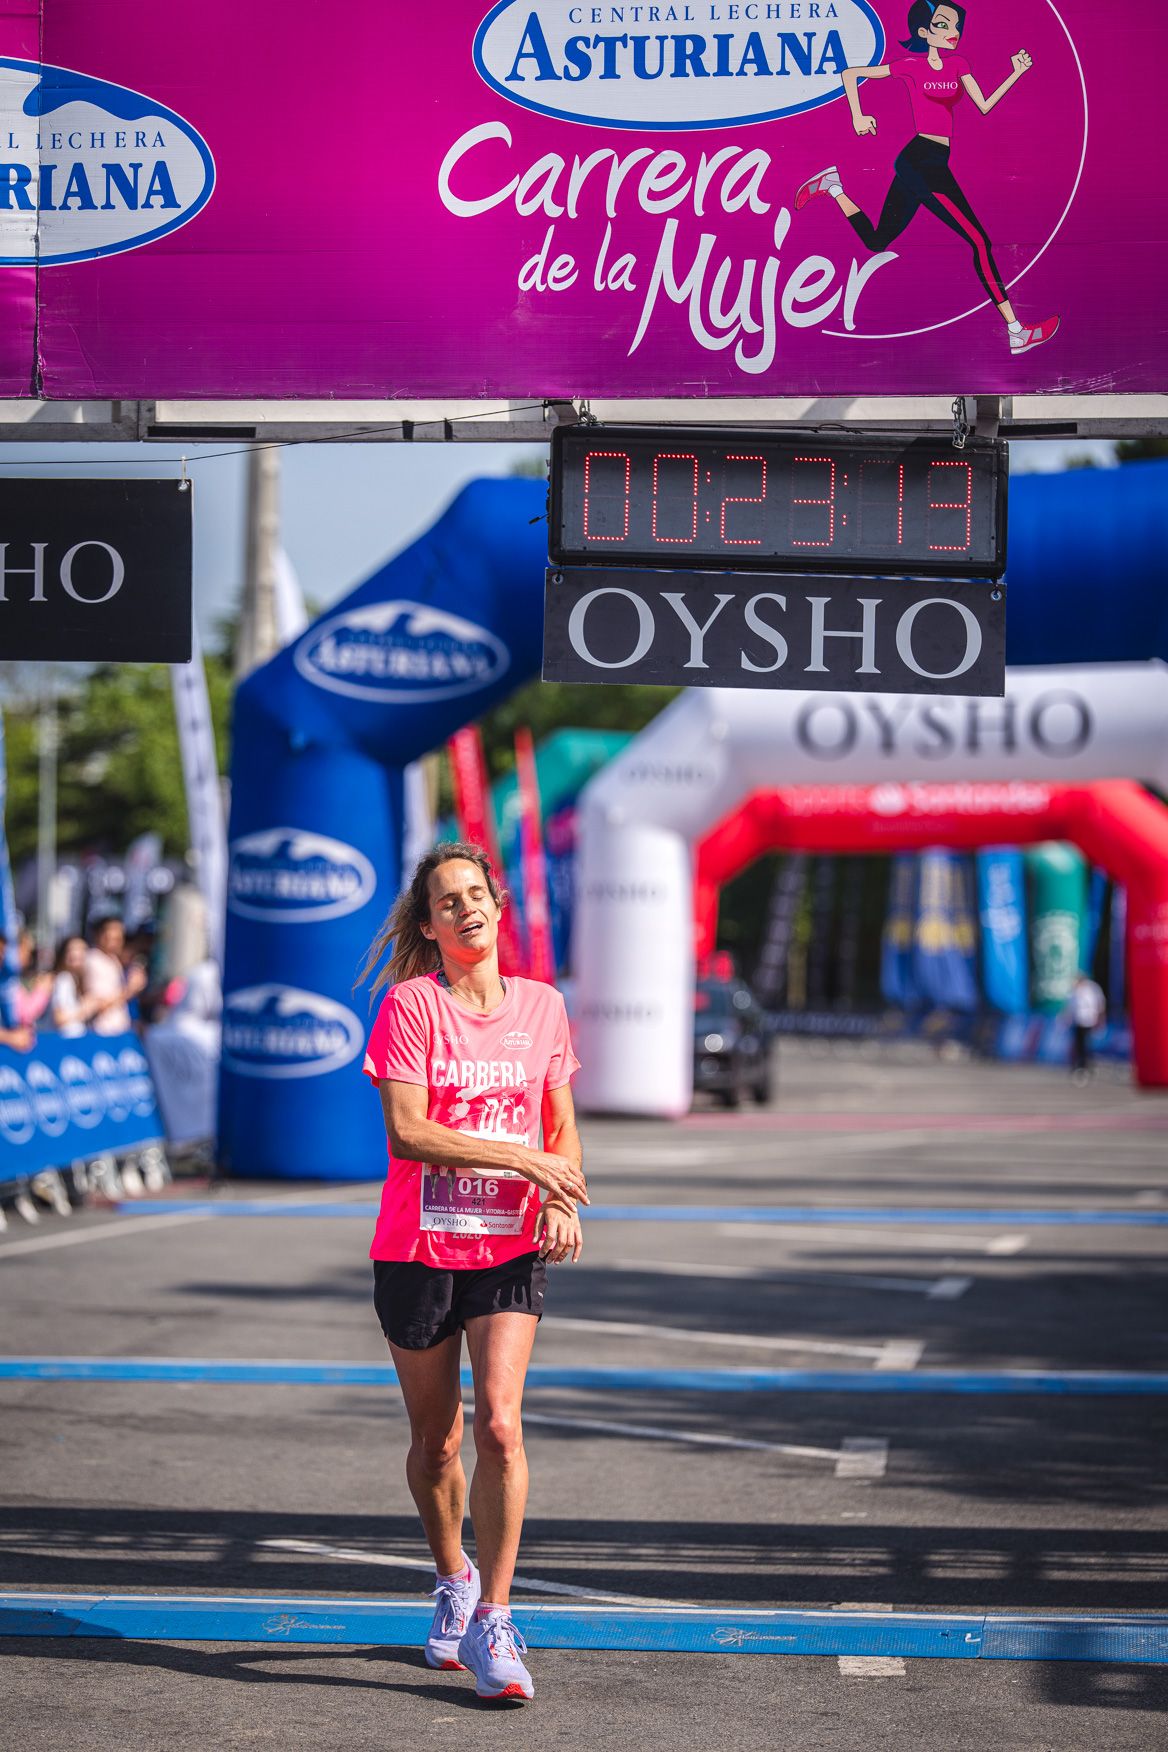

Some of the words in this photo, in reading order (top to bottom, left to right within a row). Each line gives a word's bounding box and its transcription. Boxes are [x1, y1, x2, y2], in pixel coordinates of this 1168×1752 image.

[568, 5, 695, 24] CENTRAL
[709, 2, 839, 21] LECHERA
[504, 11, 849, 82] ASTURIANA
[923, 81, 958, 90] OYSHO
[35, 131, 167, 150] LECHERA
[437, 121, 772, 218] Carrera
[517, 224, 579, 293] de
[593, 220, 637, 292] la
[627, 206, 900, 375] Mujer
[567, 587, 983, 680] OYSHO
[793, 689, 1095, 762] OYSHO
[458, 1177, 499, 1197] 016
[472, 1198, 486, 1206] 421
[433, 1216, 468, 1227] OYSHO
